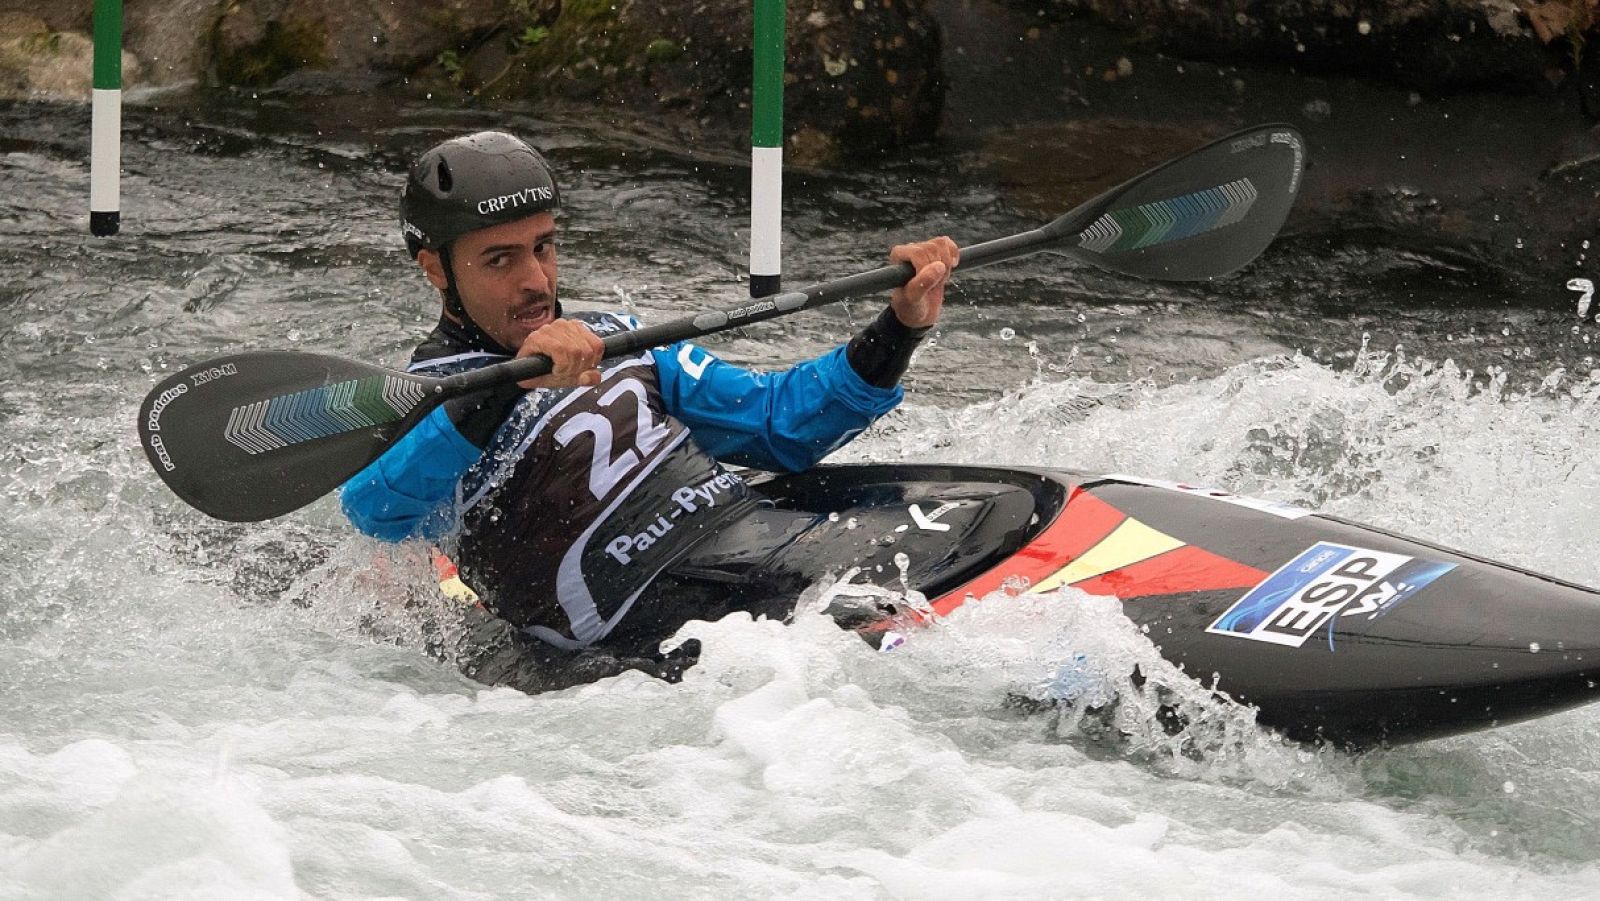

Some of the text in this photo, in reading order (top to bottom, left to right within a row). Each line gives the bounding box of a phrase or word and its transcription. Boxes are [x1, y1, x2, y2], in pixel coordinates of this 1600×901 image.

[477, 186, 553, 215] CRPTVTNS
[148, 362, 238, 472] raab paddles X16-M
[552, 378, 671, 501] 22
[1261, 556, 1379, 638] ESP
